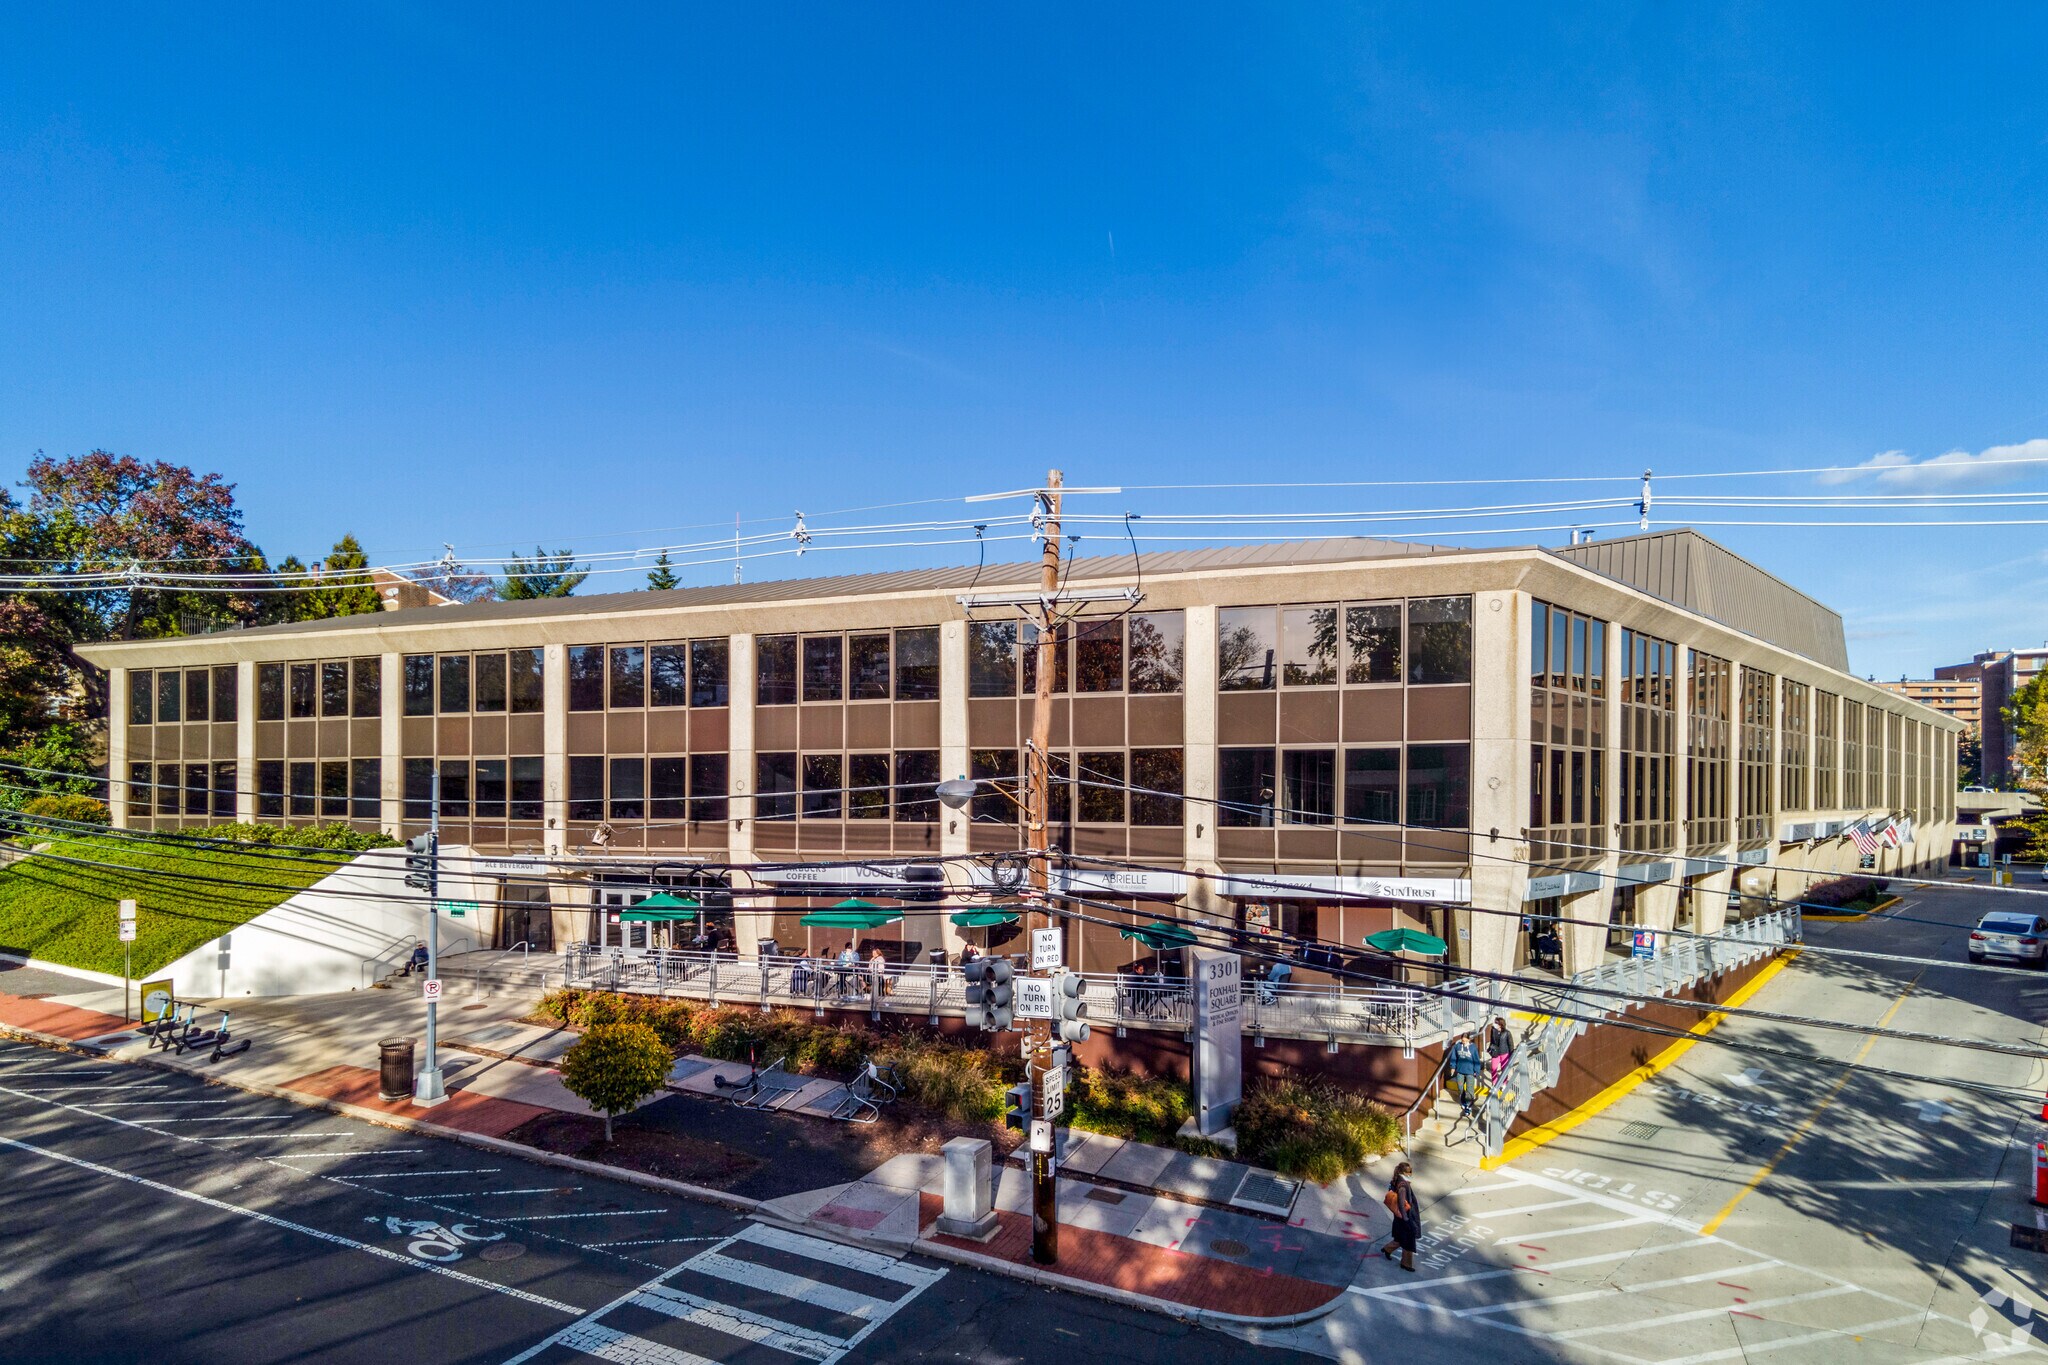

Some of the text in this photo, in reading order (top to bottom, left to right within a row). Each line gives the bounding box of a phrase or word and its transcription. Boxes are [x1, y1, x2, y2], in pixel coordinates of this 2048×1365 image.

[786, 873, 818, 881] COFFEE
[1102, 873, 1148, 885] ABRIELLE
[1042, 934, 1053, 942] NO
[1039, 944, 1056, 953] TURN
[1035, 954, 1059, 964] ON RED
[1209, 960, 1238, 980] 3301
[1027, 985, 1041, 993] NO
[1209, 984, 1238, 998] FOXHALL
[1023, 994, 1046, 1002] TURN
[1211, 994, 1237, 1009] SQUARE
[1034, 1005, 1050, 1013] RED
[1045, 1070, 1062, 1085] SPEED
[1046, 1082, 1060, 1094] LIMIT
[1046, 1092, 1061, 1114] 25
[1391, 1214, 1472, 1261] DRIVEW
[1420, 1225, 1494, 1270] CAUTION
